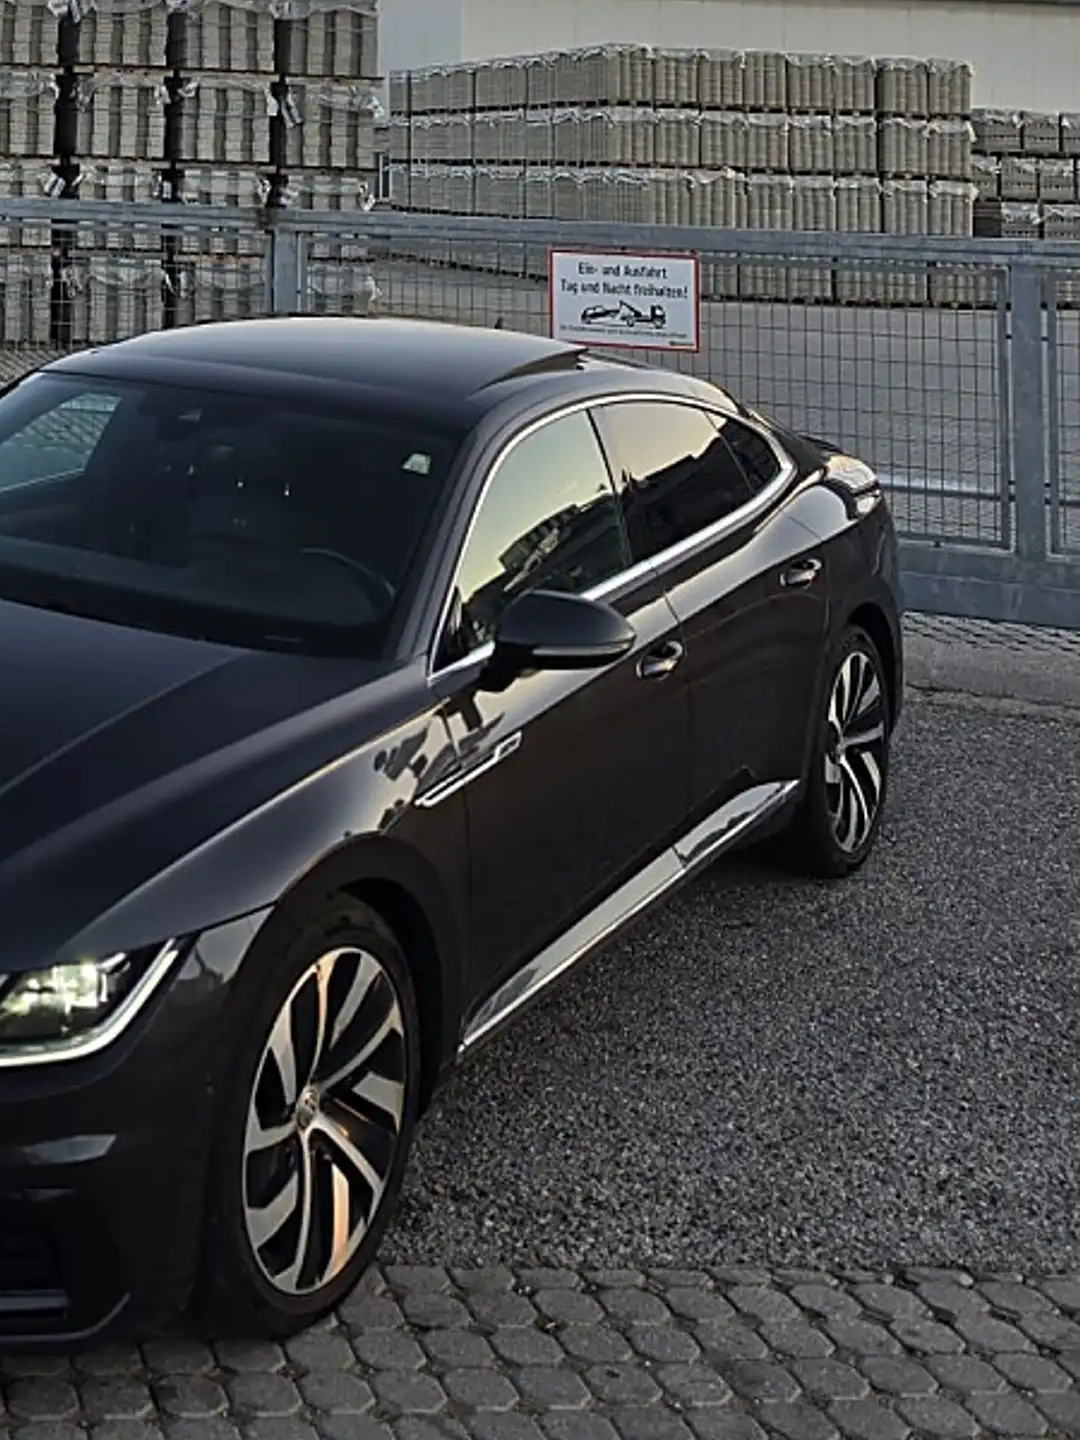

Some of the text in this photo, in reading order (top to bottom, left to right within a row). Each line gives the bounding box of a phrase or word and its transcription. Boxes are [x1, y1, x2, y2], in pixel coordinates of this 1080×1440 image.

[578, 262, 667, 279] Ein- und Ausfahrt
[561, 279, 578, 295] Tag
[581, 283, 599, 294] und
[602, 283, 632, 296] Nacht
